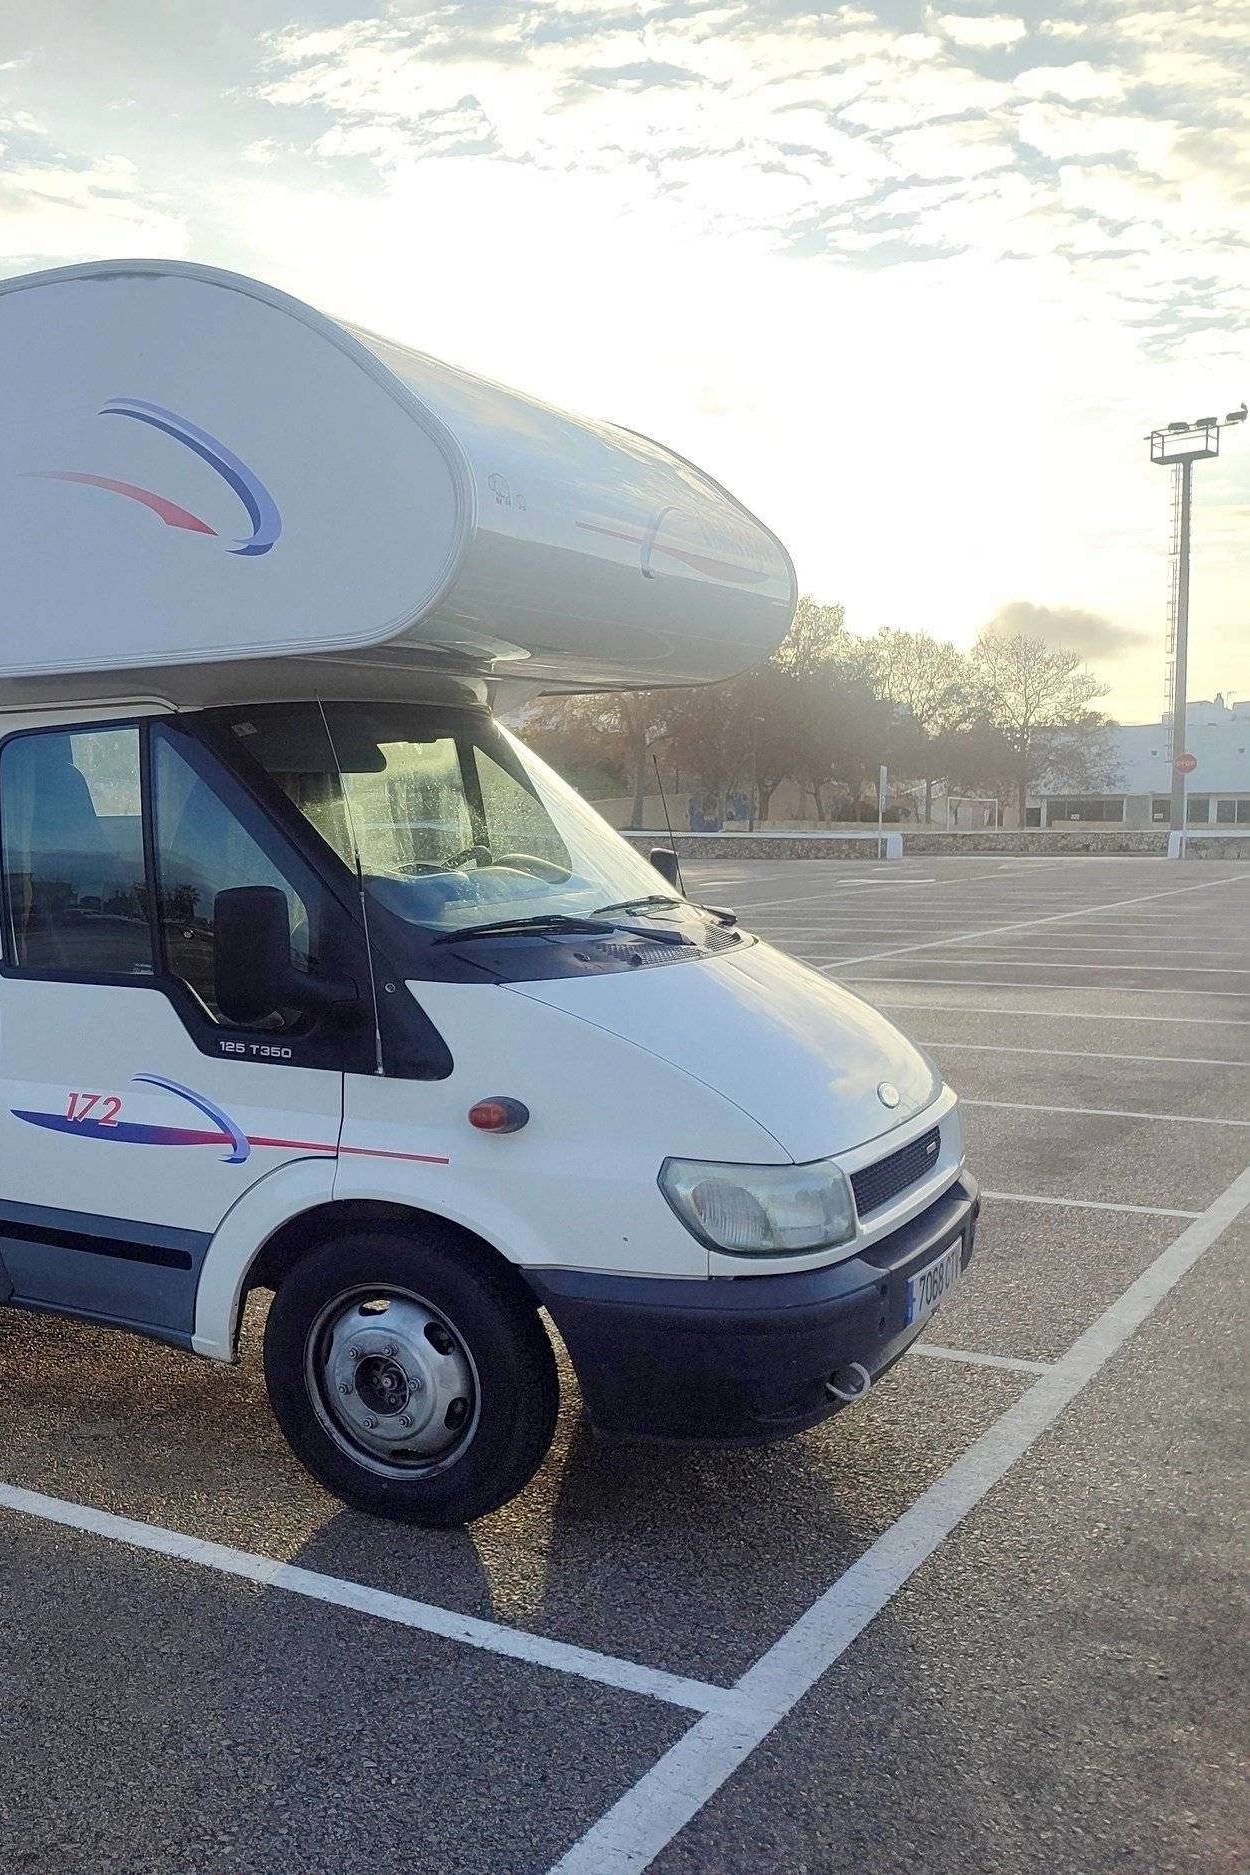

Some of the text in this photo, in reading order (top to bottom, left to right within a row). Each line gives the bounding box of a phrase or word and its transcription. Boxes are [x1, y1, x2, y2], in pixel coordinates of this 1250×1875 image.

[219, 1041, 292, 1059] 125 T350
[66, 1092, 122, 1127] 172
